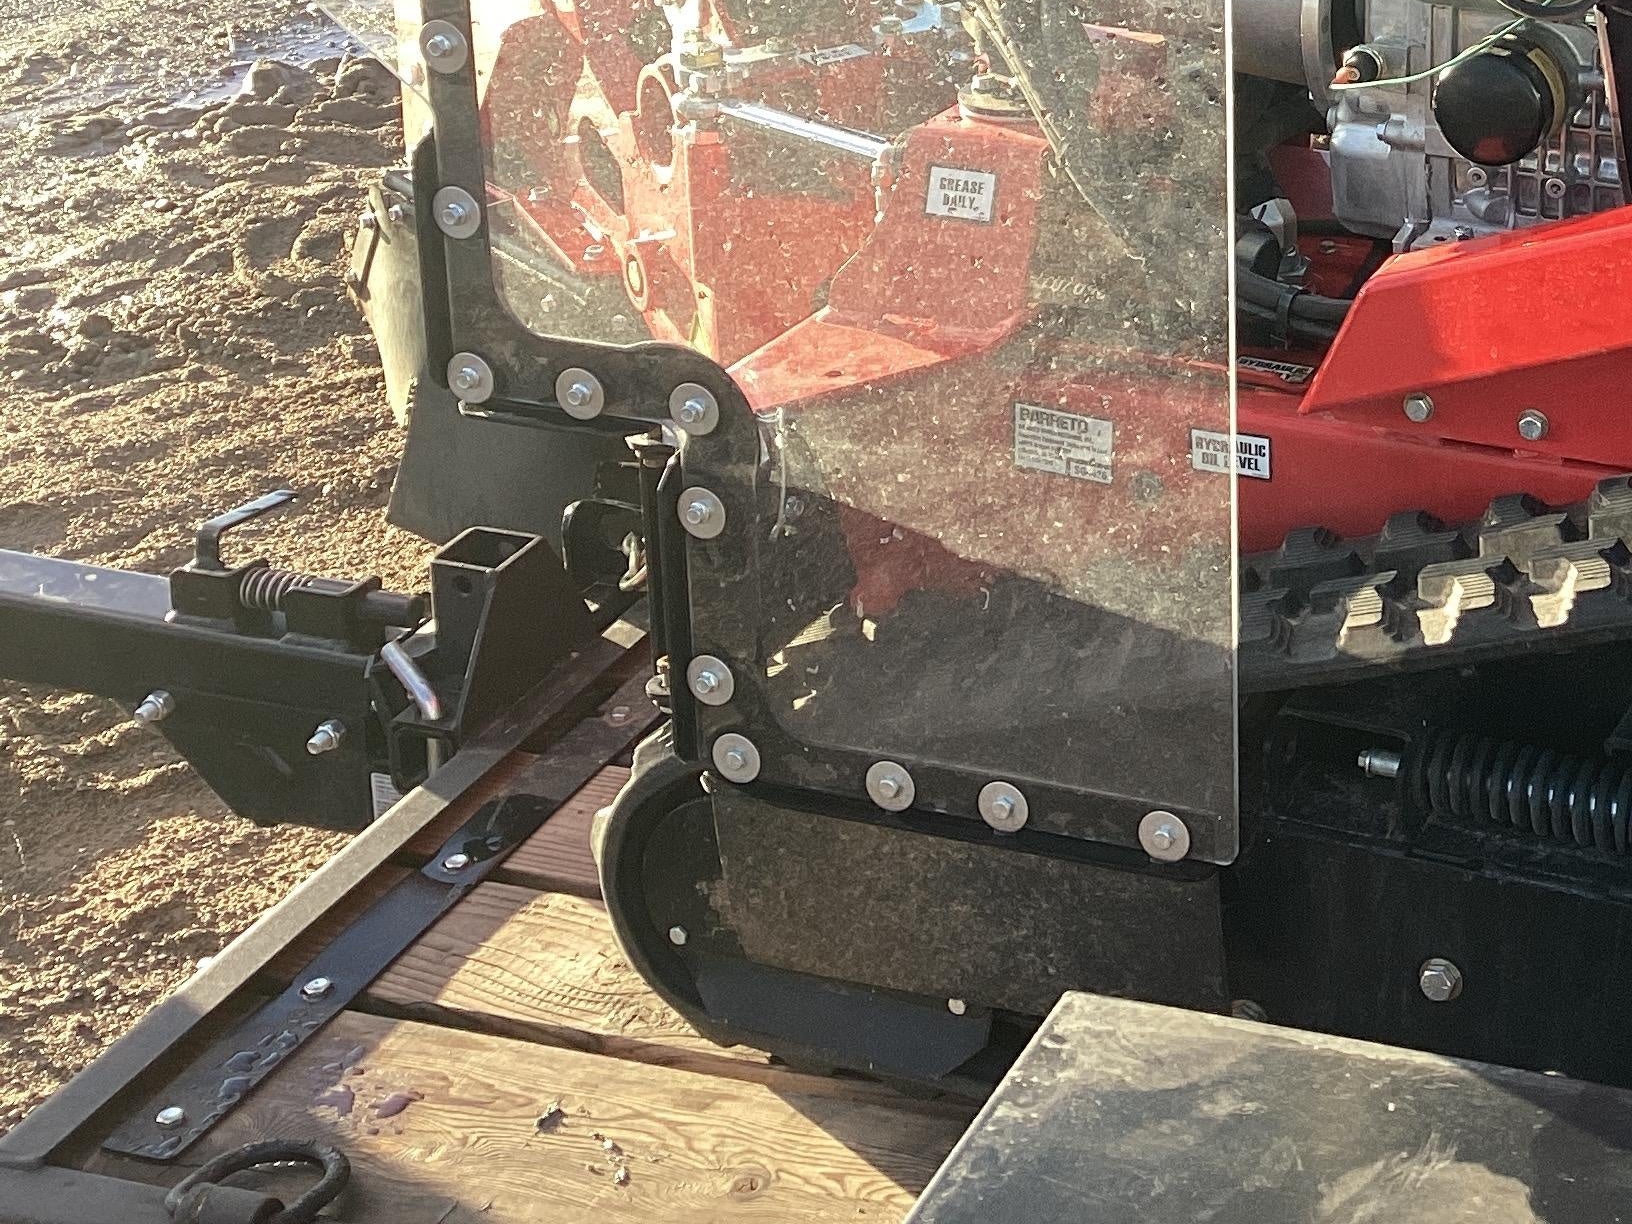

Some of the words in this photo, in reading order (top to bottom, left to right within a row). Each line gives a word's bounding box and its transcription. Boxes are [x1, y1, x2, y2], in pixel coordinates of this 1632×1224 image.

[939, 177, 985, 195] GREASE
[942, 192, 975, 209] DAILY
[1019, 407, 1089, 434] BARRETO
[1223, 455, 1262, 472] LVEL
